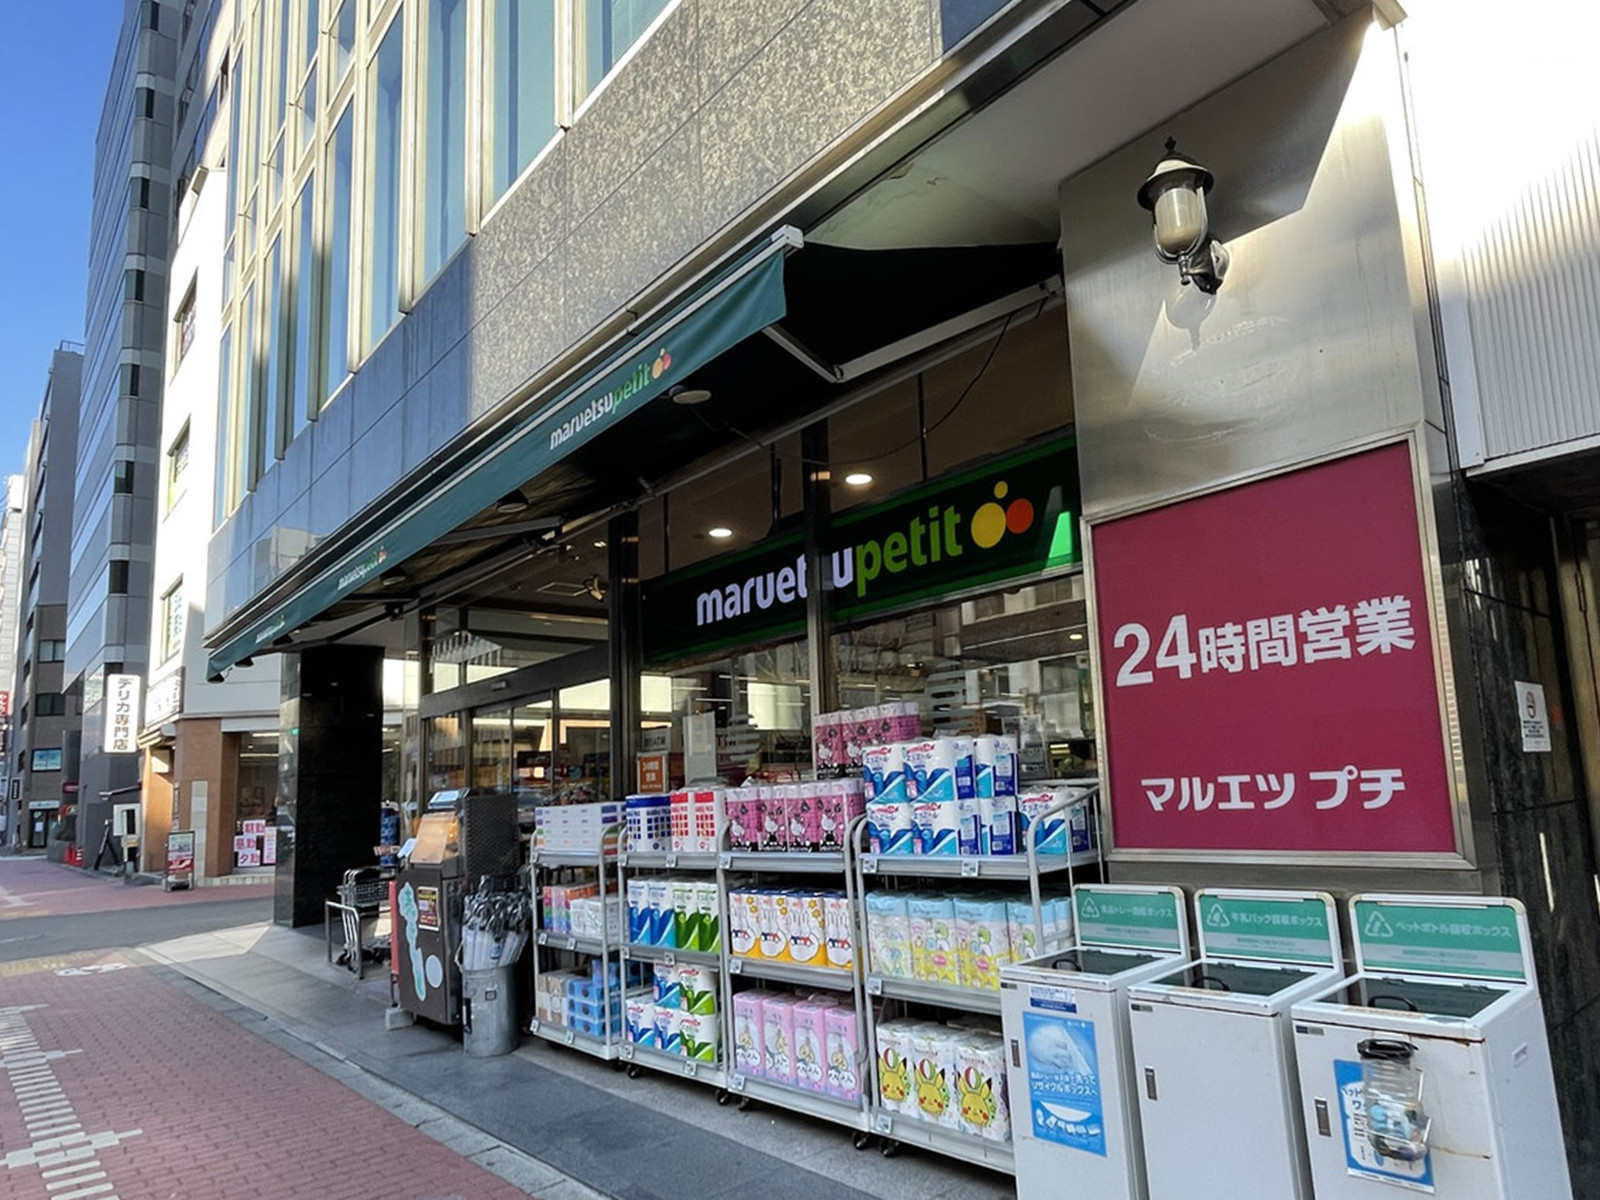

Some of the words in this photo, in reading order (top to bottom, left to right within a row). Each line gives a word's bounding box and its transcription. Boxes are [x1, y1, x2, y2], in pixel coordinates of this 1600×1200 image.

[550, 363, 650, 450] maruetsupetit
[696, 505, 963, 627] maruetupetit
[1113, 596, 1415, 687] 24時間営業
[113, 678, 133, 750] デリカ専門店
[1141, 775, 1294, 811] マルエツ
[1308, 765, 1406, 810] プチ
